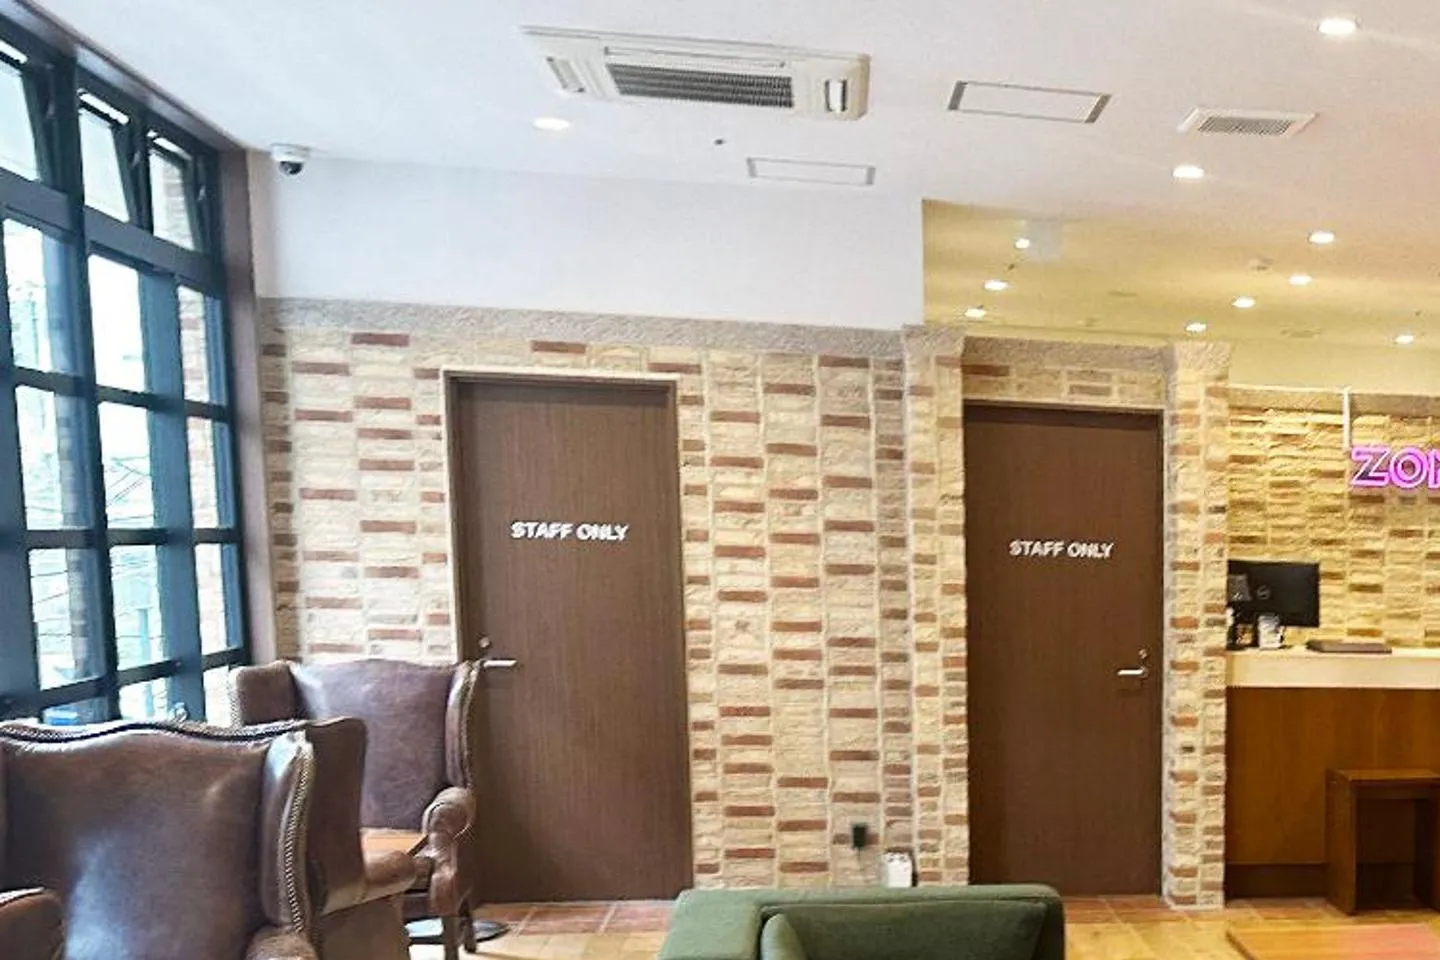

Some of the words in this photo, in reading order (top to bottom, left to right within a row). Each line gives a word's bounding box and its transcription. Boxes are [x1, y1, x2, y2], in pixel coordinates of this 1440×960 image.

[511, 521, 573, 539] STAFF
[576, 523, 630, 541] ONLY
[1009, 540, 1065, 557] STAFF
[1067, 542, 1115, 559] ONLY
